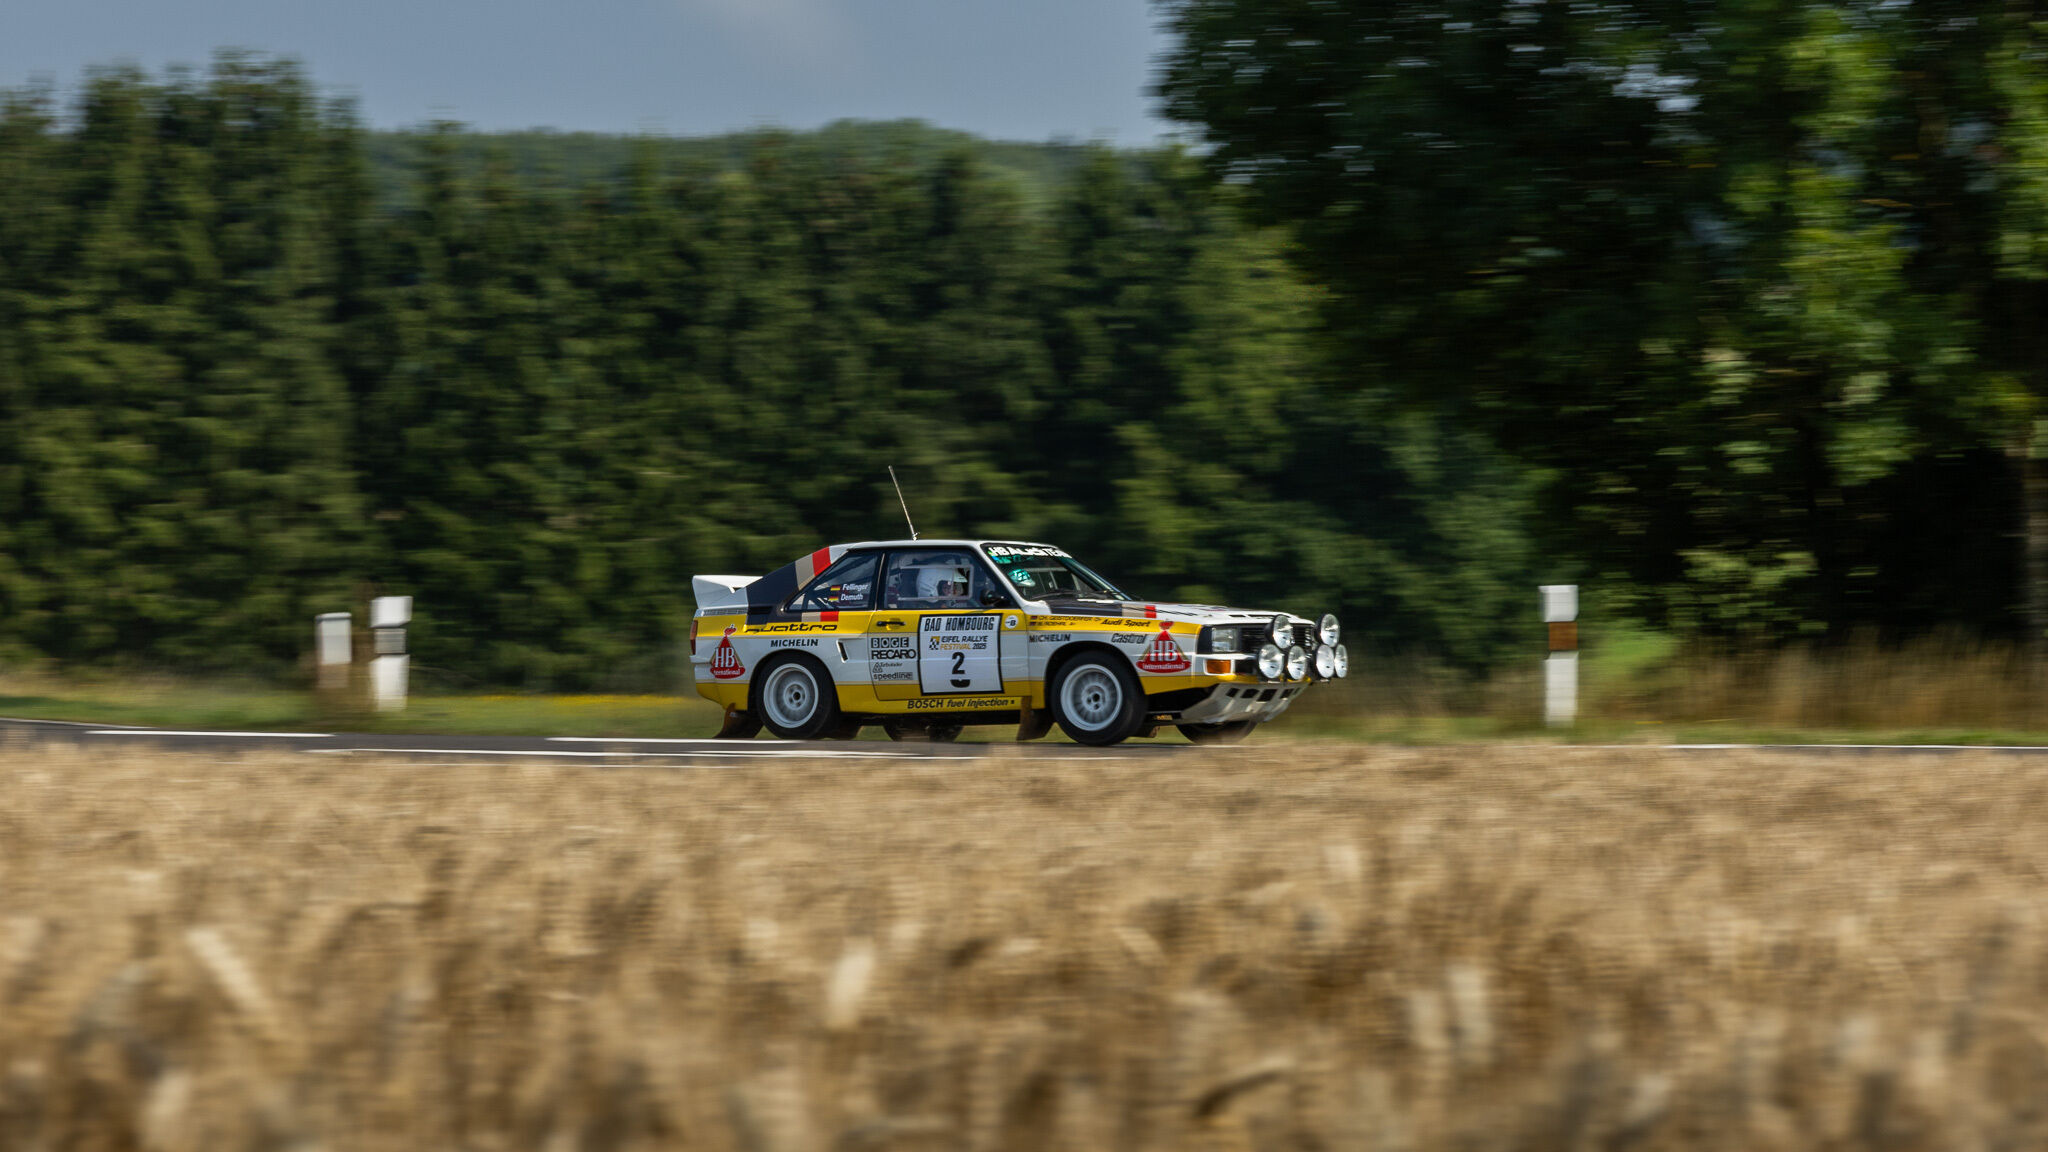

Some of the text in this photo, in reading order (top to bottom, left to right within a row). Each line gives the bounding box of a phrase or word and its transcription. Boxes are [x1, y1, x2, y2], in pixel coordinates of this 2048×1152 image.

[988, 546, 1009, 556] HB
[842, 584, 869, 592] Fellinger
[745, 623, 837, 633] quattro
[924, 617, 995, 631] BAD HOMBOURG
[1124, 619, 1151, 628] Sport
[770, 639, 819, 647] MICHELIN
[871, 637, 909, 648] BOGE
[1029, 634, 1071, 643] MICHELIN
[1111, 633, 1147, 644] Castrol
[872, 649, 916, 659] RECARO
[1150, 640, 1177, 661] HB
[714, 647, 735, 668] HB
[952, 652, 965, 674] 2
[873, 672, 912, 680] speedline
[907, 698, 1009, 709] BOSCH fuel injection
